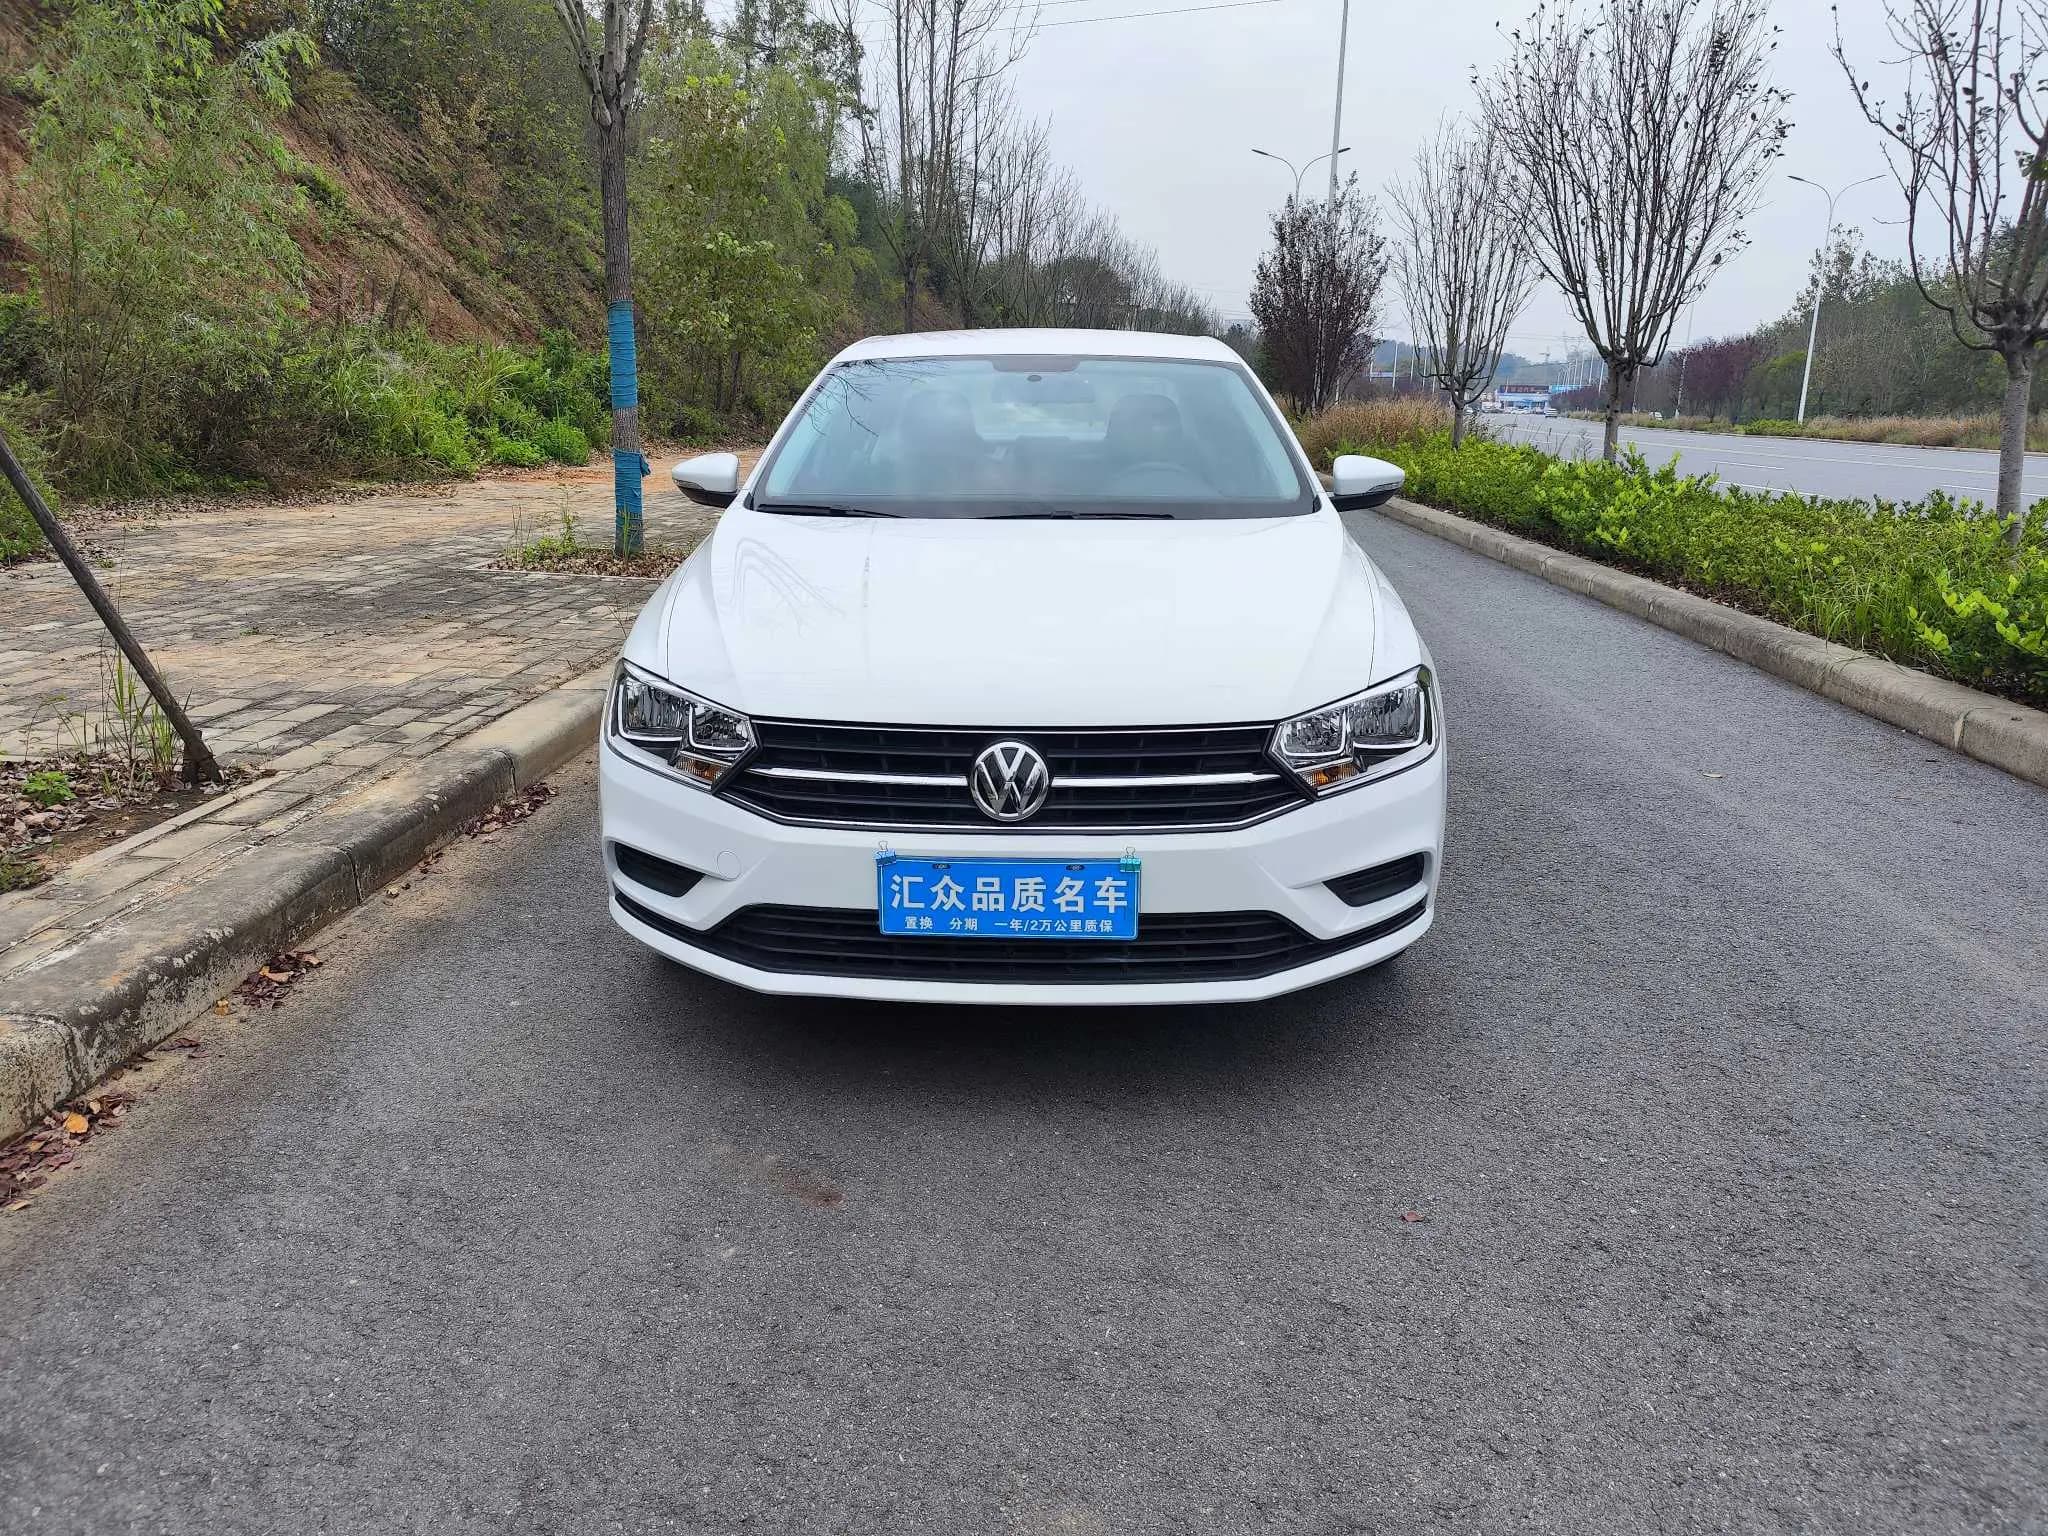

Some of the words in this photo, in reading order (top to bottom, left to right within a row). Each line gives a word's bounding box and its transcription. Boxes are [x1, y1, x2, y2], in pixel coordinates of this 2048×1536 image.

[973, 743, 1045, 818] VW
[890, 874, 1128, 913] 汇众品质名车
[905, 916, 933, 930] 置换
[950, 917, 978, 930] 分期
[995, 918, 1113, 932] 一年/2万公里质保
